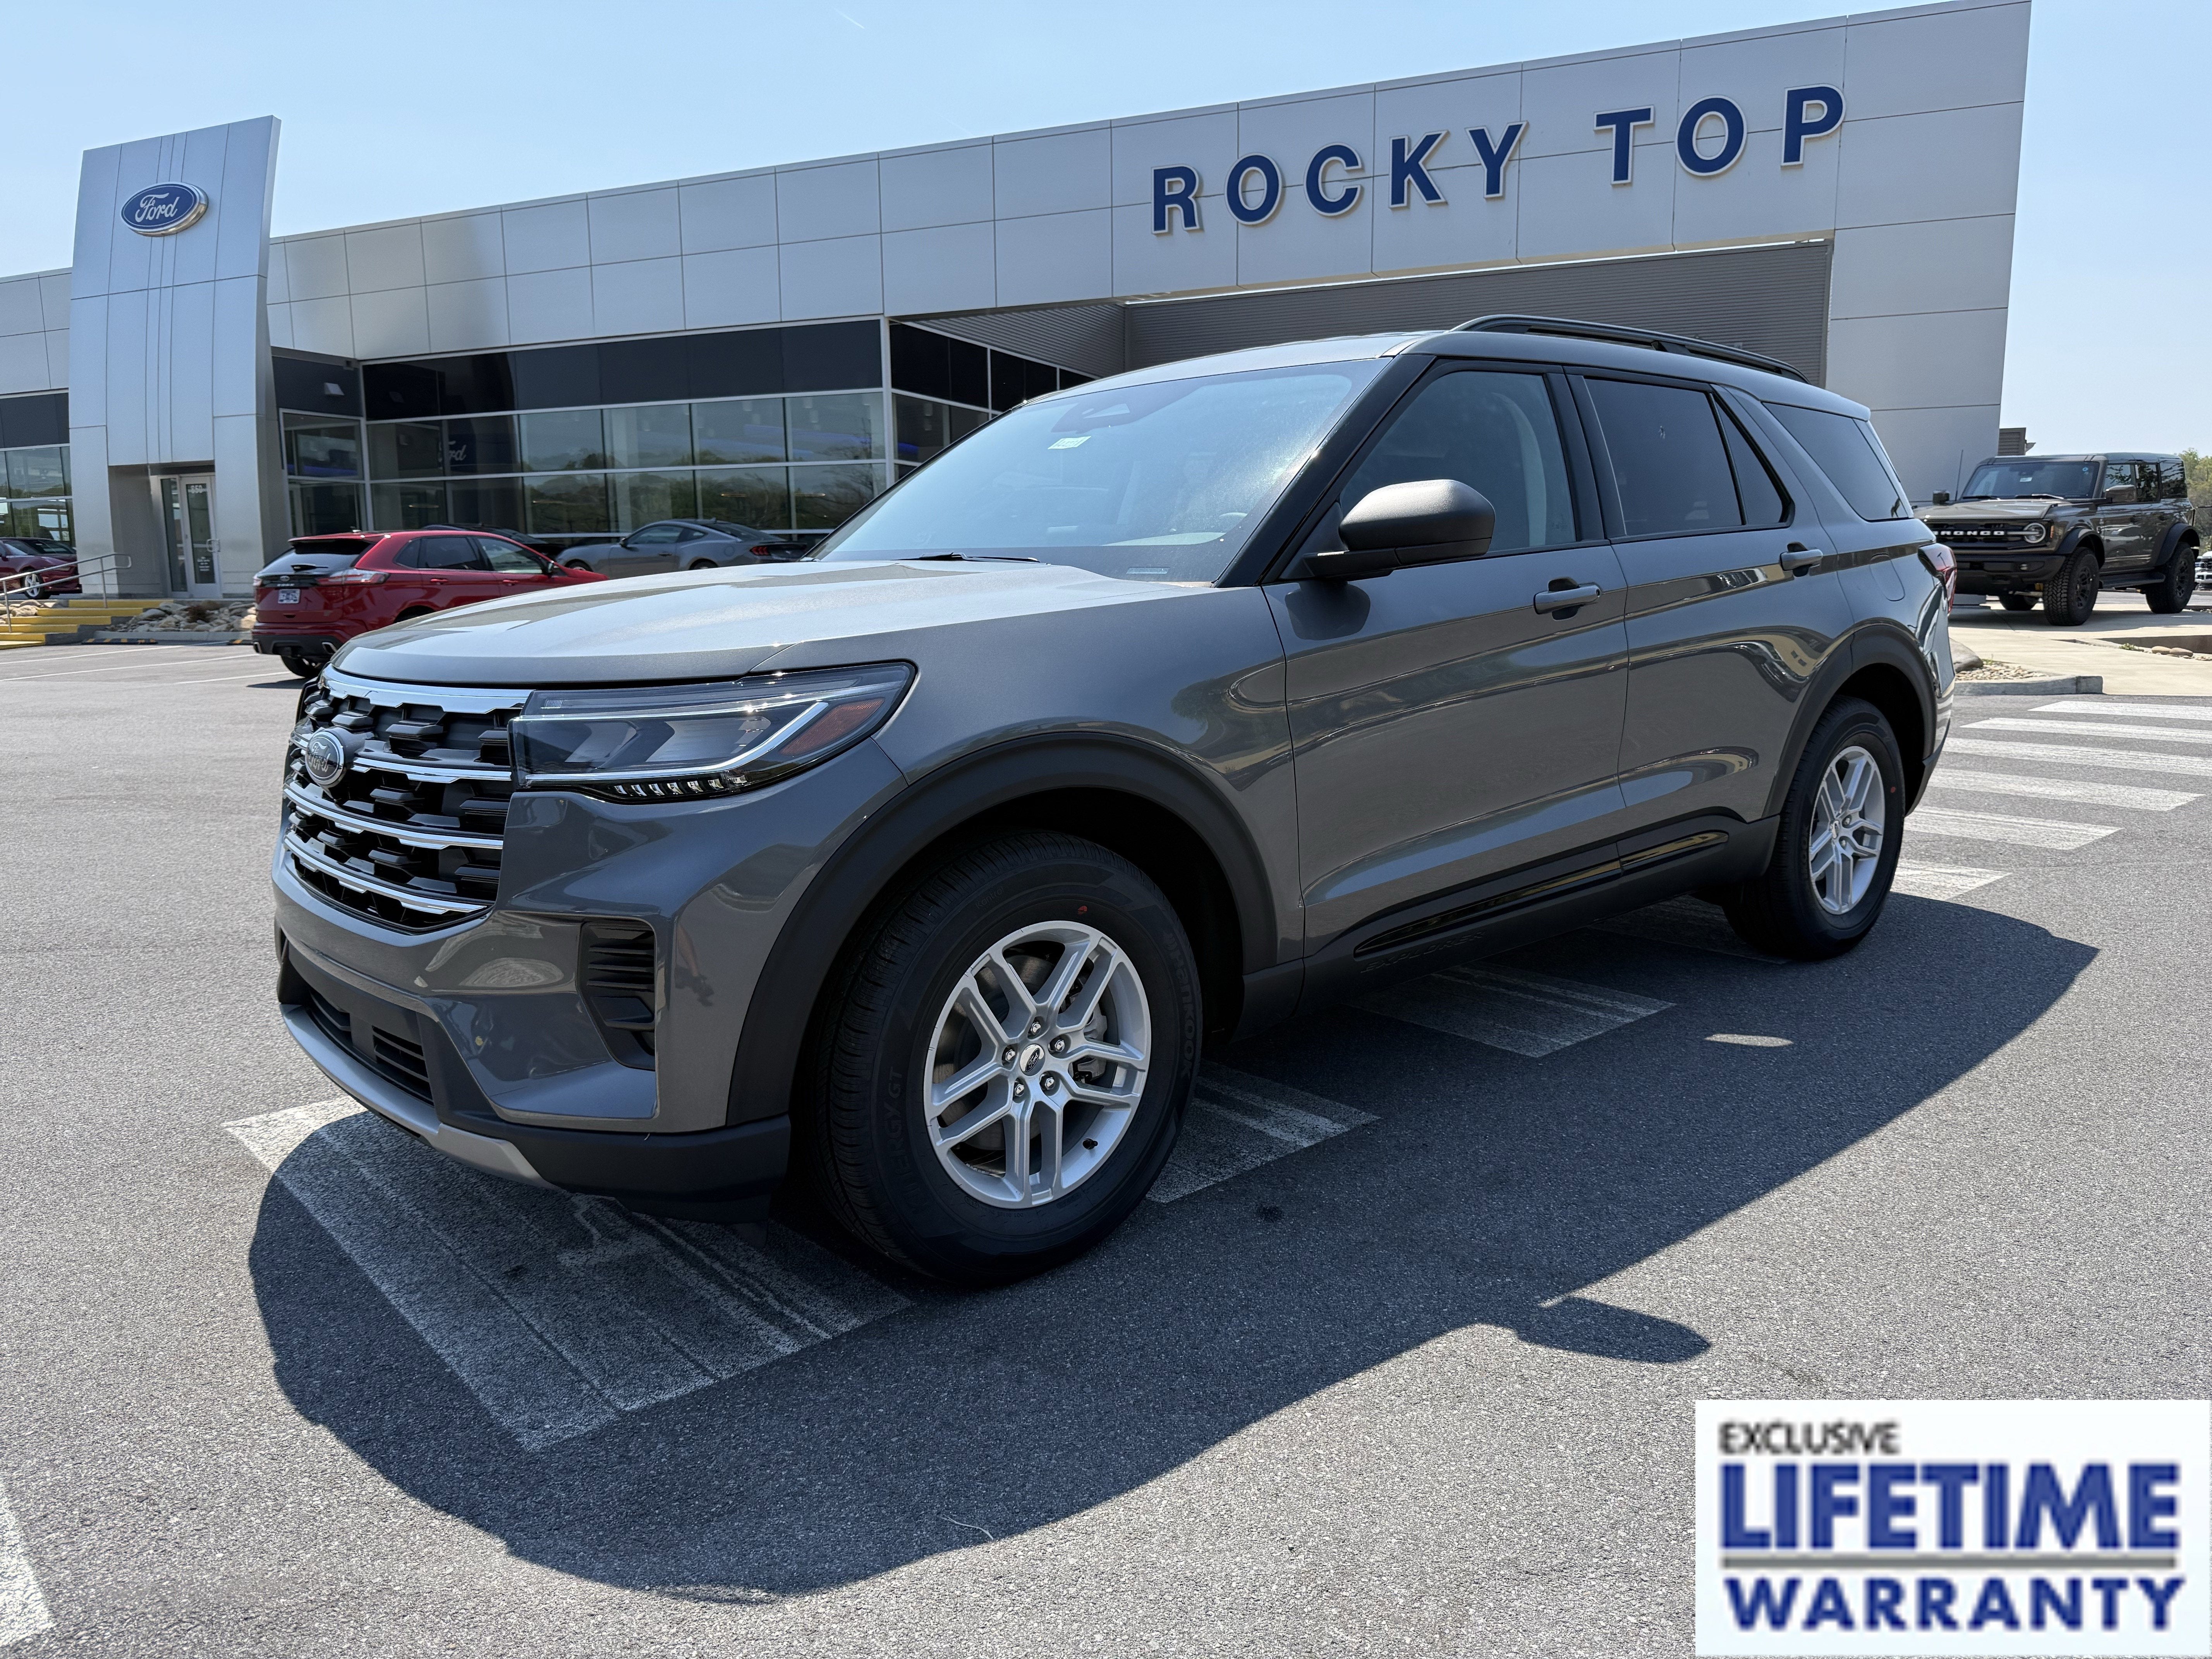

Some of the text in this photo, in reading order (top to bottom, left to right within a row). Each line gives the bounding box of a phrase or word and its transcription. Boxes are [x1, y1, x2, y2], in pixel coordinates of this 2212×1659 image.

[1152, 83, 1846, 234] ROCKY TOP
[135, 192, 180, 223] Ford
[308, 742, 331, 772] Ford
[1360, 930, 1486, 974] EXPLORER
